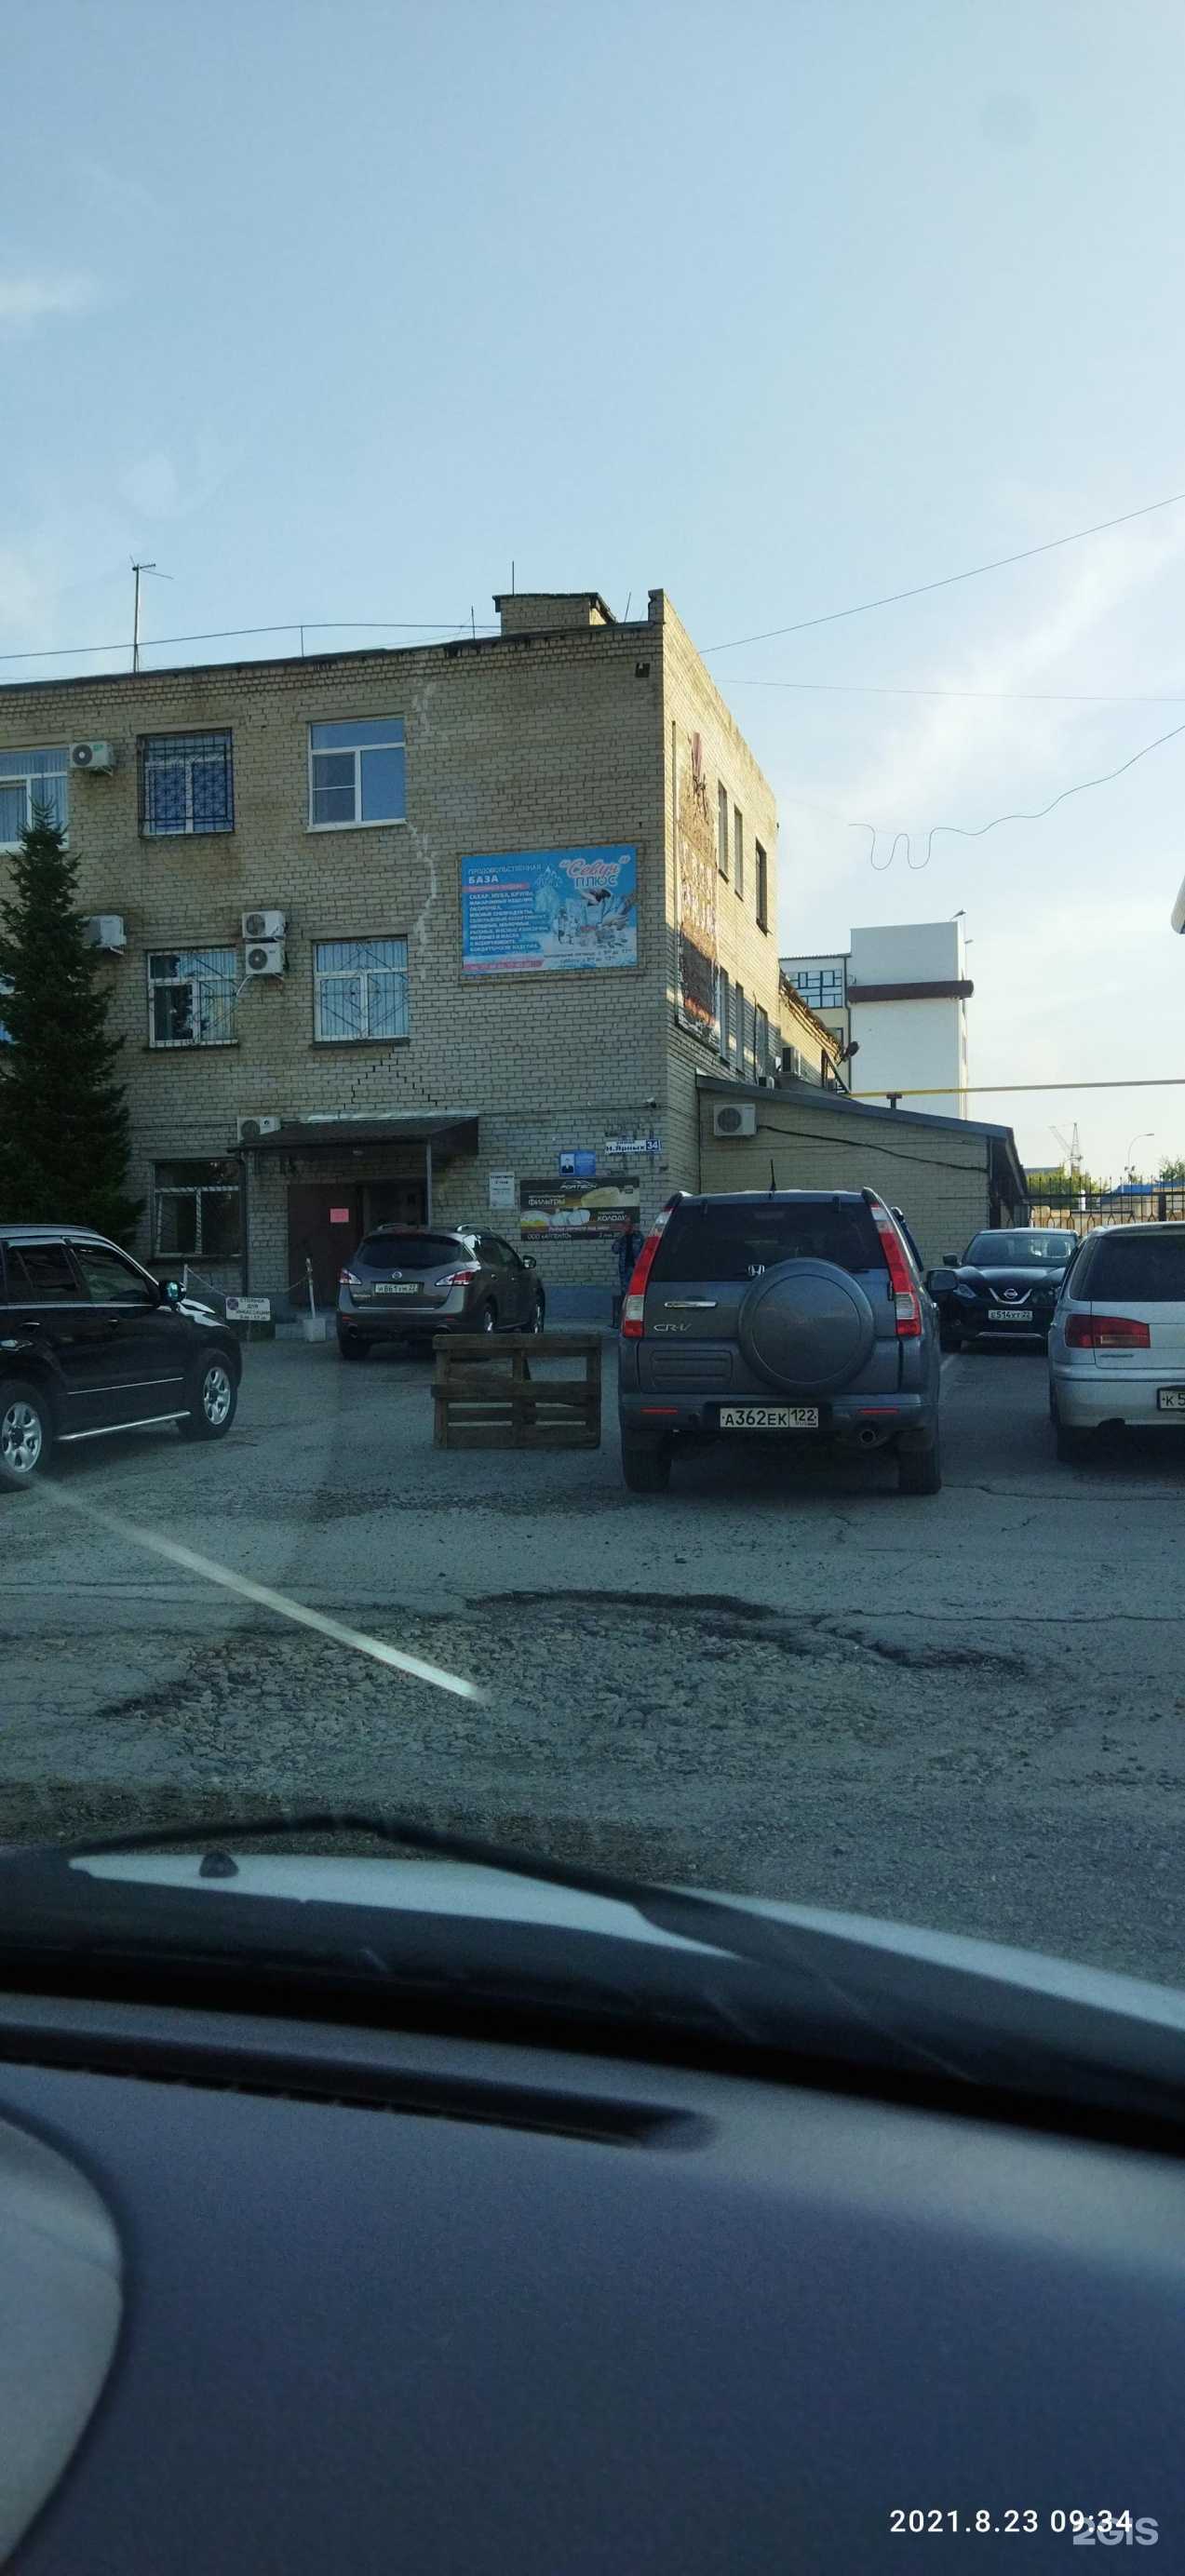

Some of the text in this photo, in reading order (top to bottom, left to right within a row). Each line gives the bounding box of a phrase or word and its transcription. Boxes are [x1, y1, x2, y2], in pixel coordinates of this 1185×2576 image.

[468, 875, 499, 885] БАЗА
[574, 875, 618, 887] ПЛЮС
[647, 1141, 659, 1150] 34
[528, 1198, 565, 1207] ФИЛЬТРЫ
[653, 1323, 693, 1332] CR-V
[725, 1409, 815, 1426] А362ЕК 122
